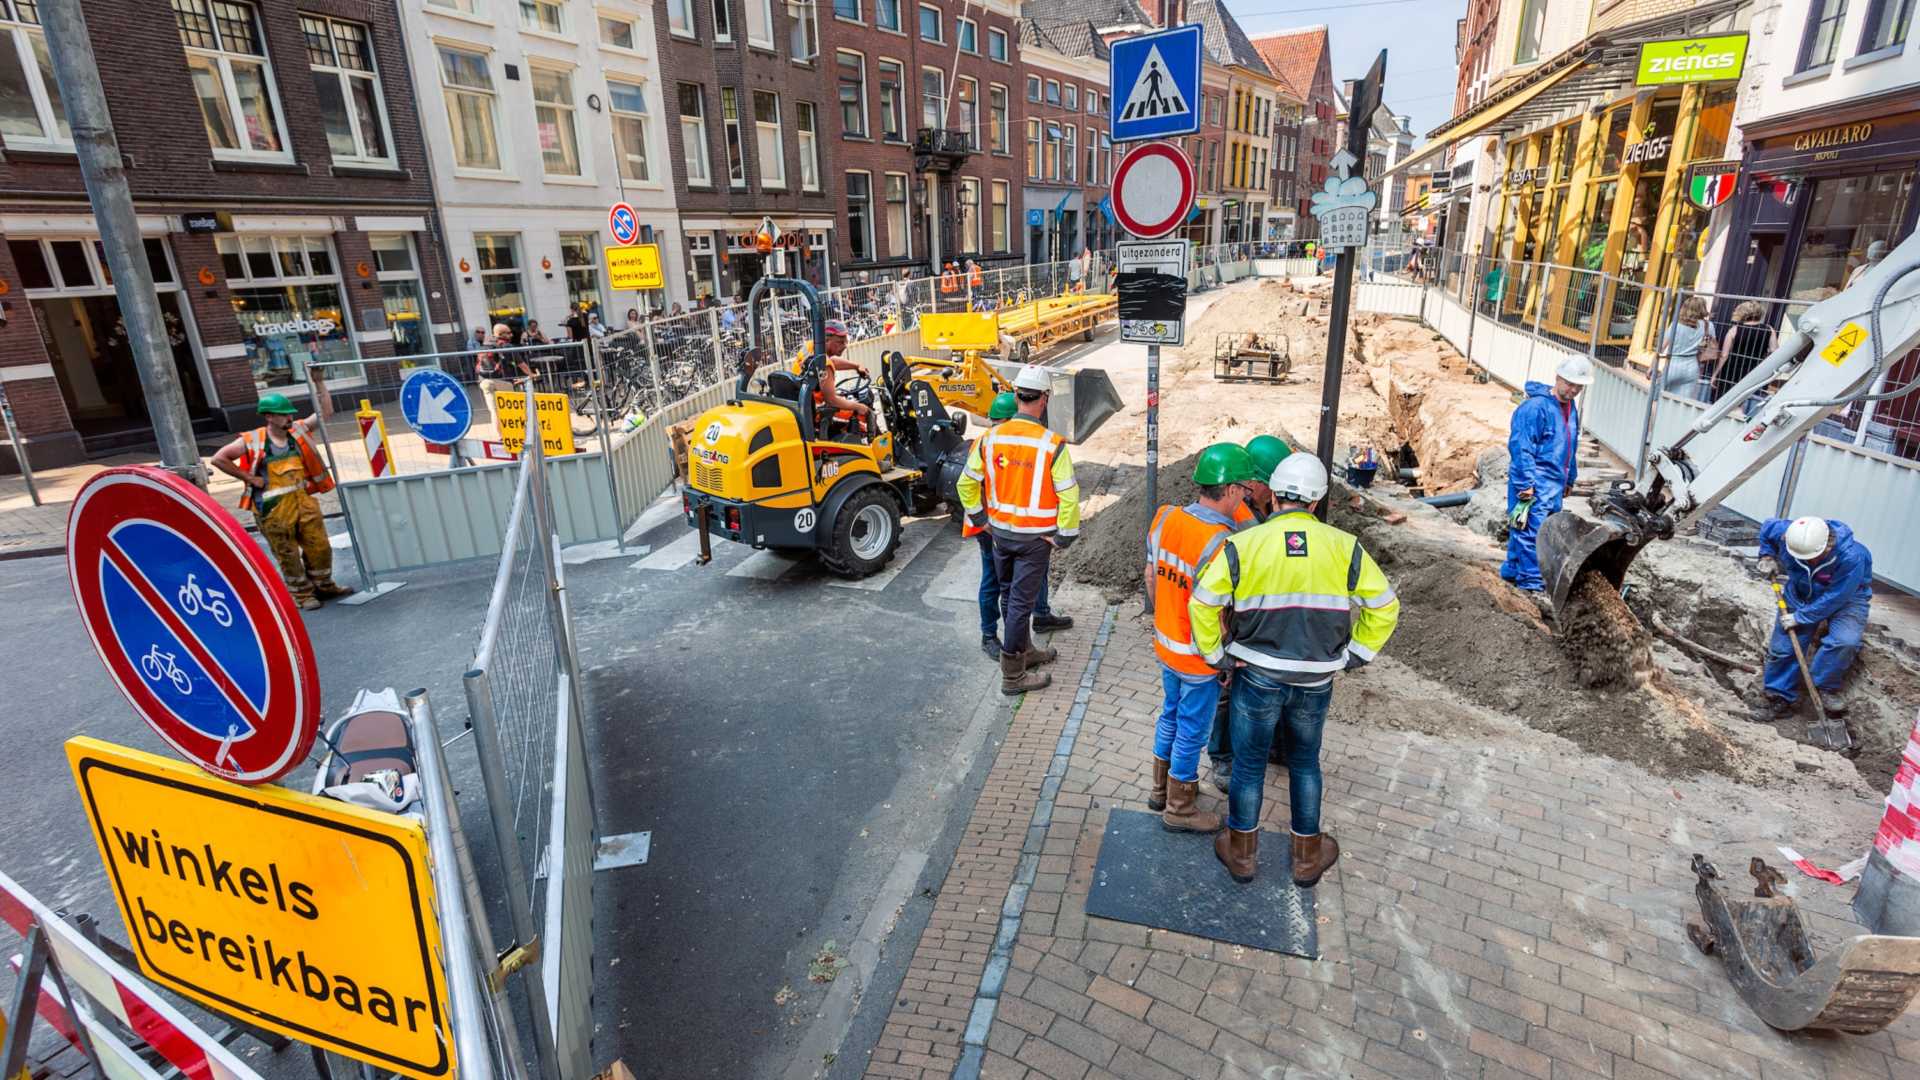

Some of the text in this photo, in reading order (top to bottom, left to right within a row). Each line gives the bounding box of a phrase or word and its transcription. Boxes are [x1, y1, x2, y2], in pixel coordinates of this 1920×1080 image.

[1648, 51, 1736, 73] ZIENGS
[1794, 124, 1872, 151] CAVALLARO
[1624, 136, 1669, 164] ZIENGS
[611, 256, 643, 267] winkels
[1122, 247, 1180, 260] uitgezonderd
[613, 271, 658, 282] bereikbaar
[253, 318, 335, 336] travelbags
[706, 424, 720, 441] 20
[821, 462, 839, 479] 406
[798, 511, 814, 529] 20
[113, 825, 320, 921] winkels
[137, 896, 427, 1033] bereikbaar
